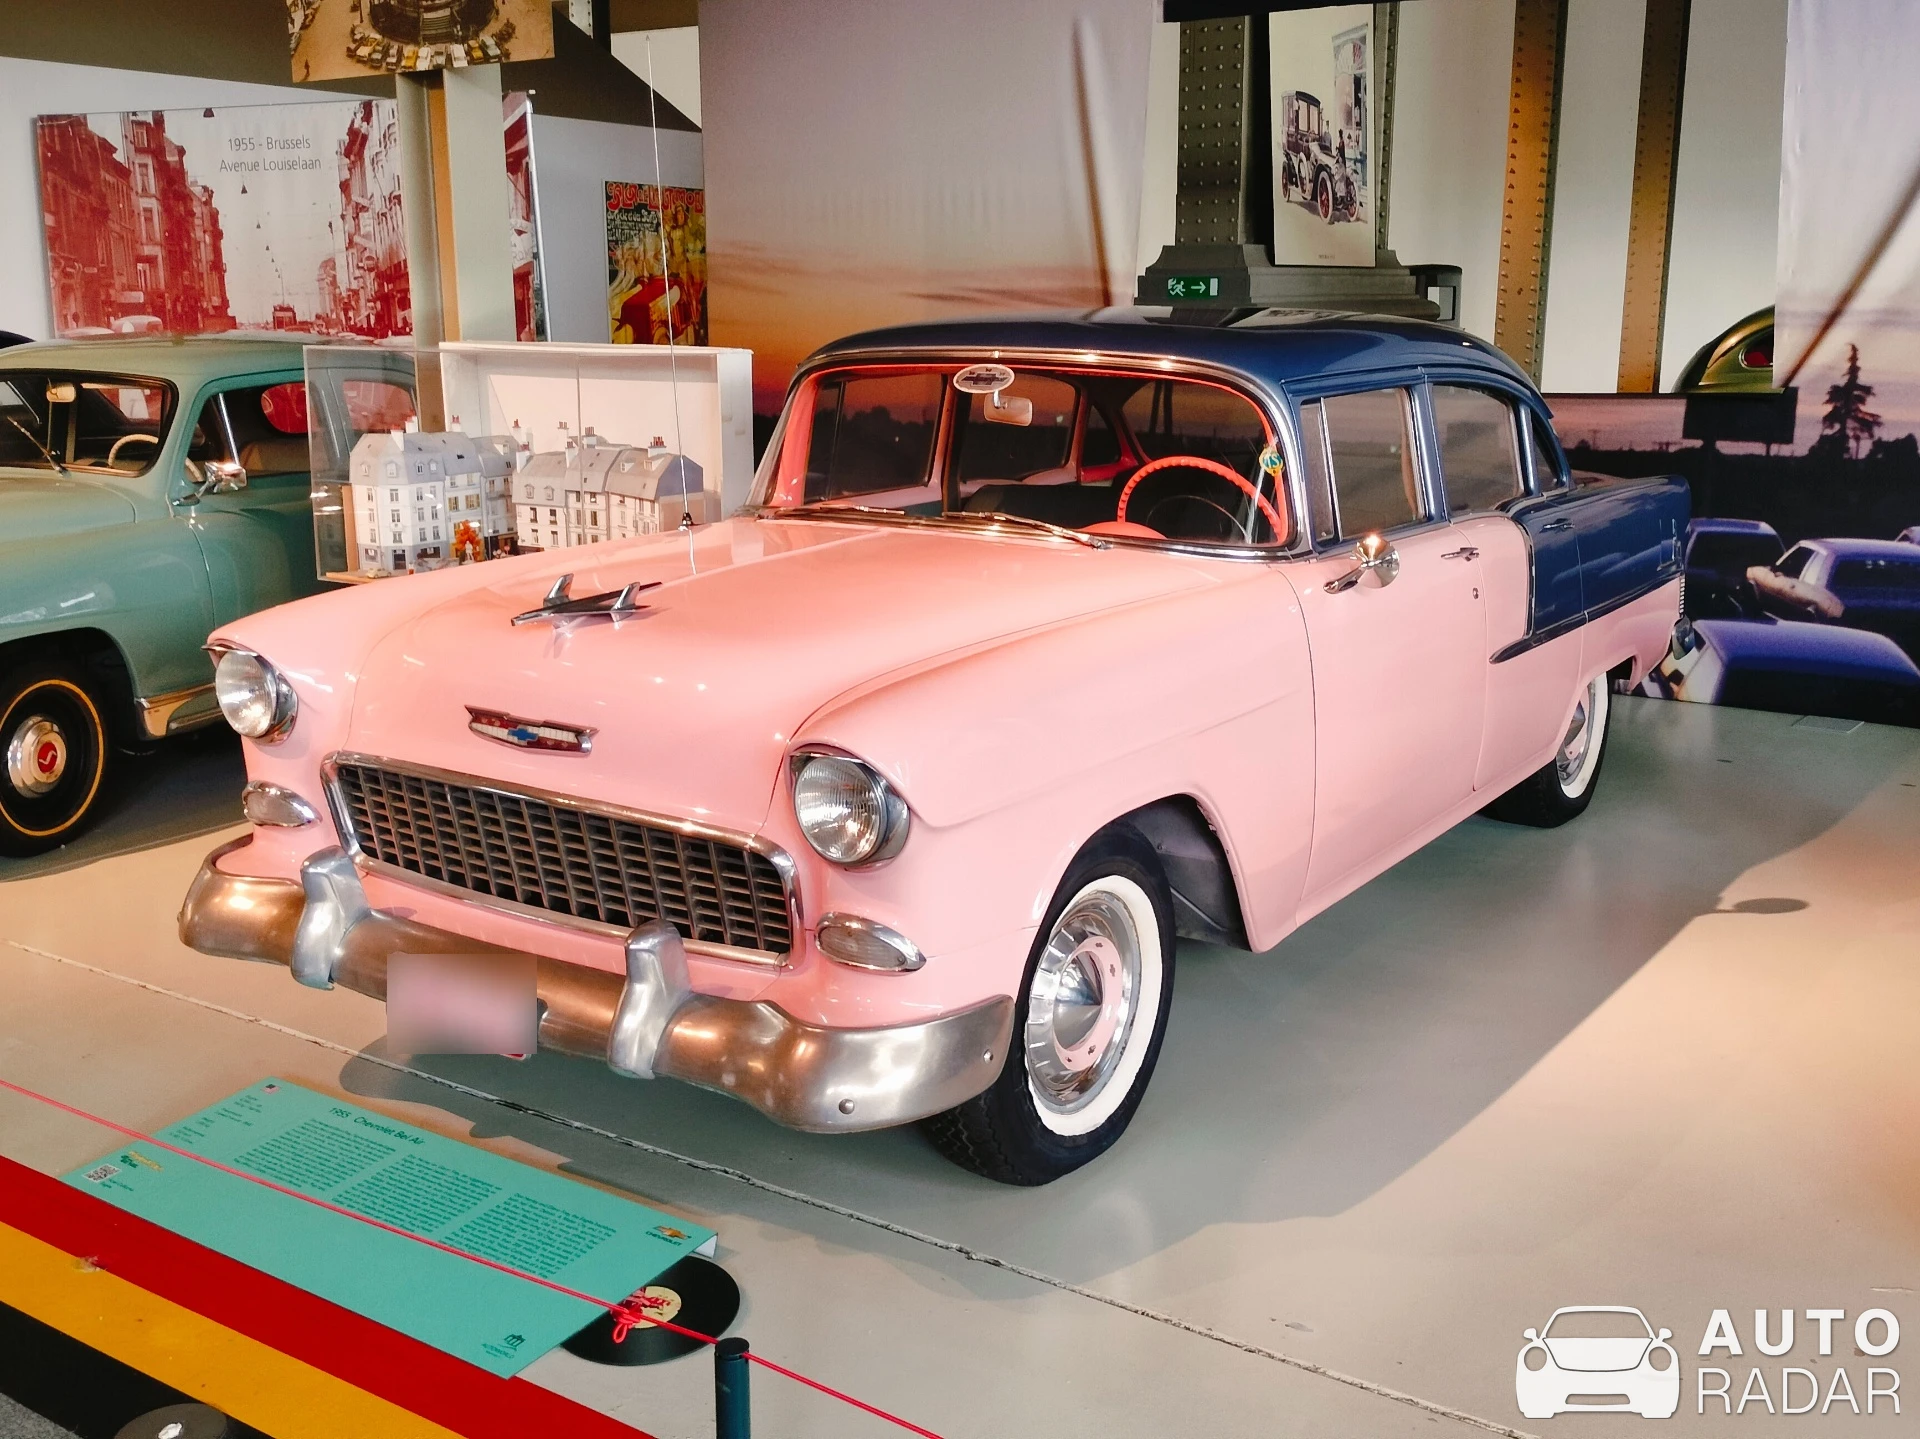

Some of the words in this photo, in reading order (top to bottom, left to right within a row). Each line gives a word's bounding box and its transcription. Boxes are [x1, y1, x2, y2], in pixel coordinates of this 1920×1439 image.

[227, 137, 256, 152] 1955
[266, 134, 311, 150] Brussels
[219, 159, 260, 173] Avenue
[262, 155, 322, 172] Louiselaan
[329, 1107, 352, 1119] 1955
[353, 1116, 396, 1136] Chevrolet
[645, 1231, 682, 1246] CHEVROLET
